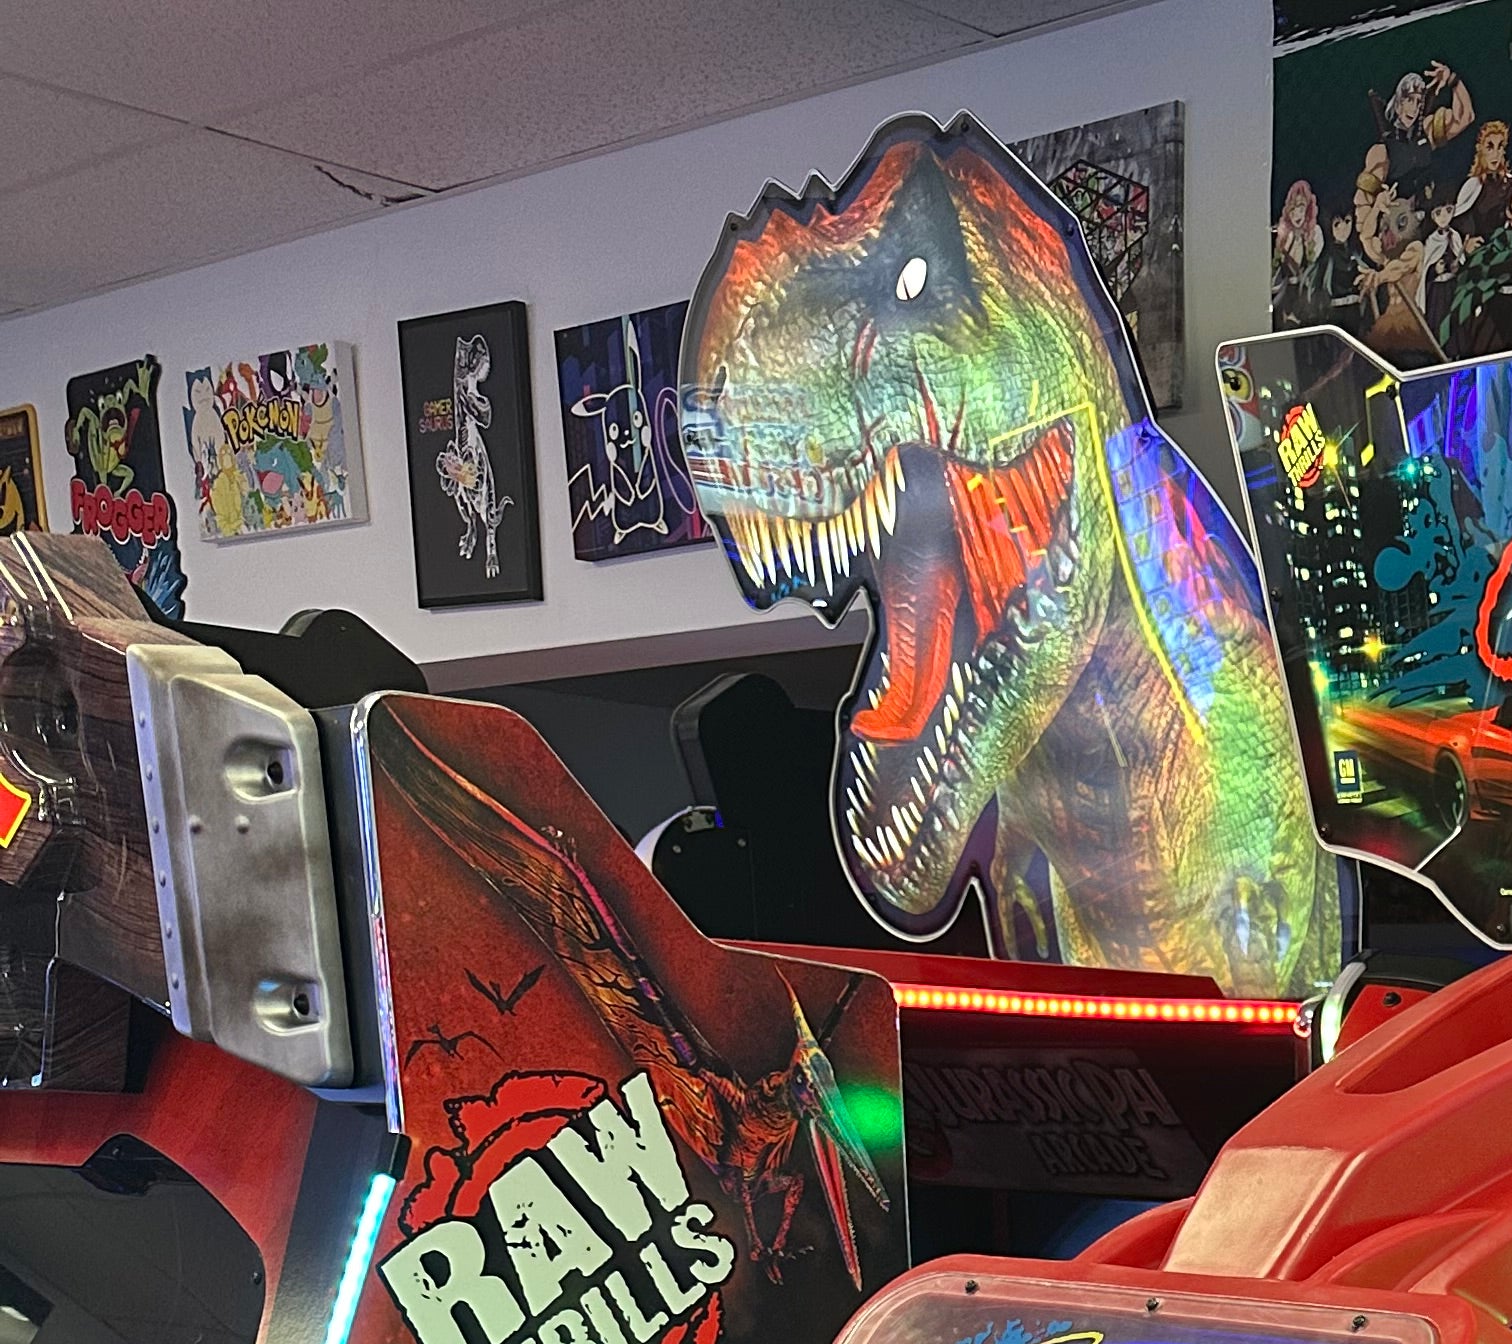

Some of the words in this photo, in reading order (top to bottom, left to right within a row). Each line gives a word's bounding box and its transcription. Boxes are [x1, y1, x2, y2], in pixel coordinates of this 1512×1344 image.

[1278, 402, 1319, 473] RAW
[70, 478, 171, 549] FROGGER
[1029, 1133, 1170, 1180] ARCADE
